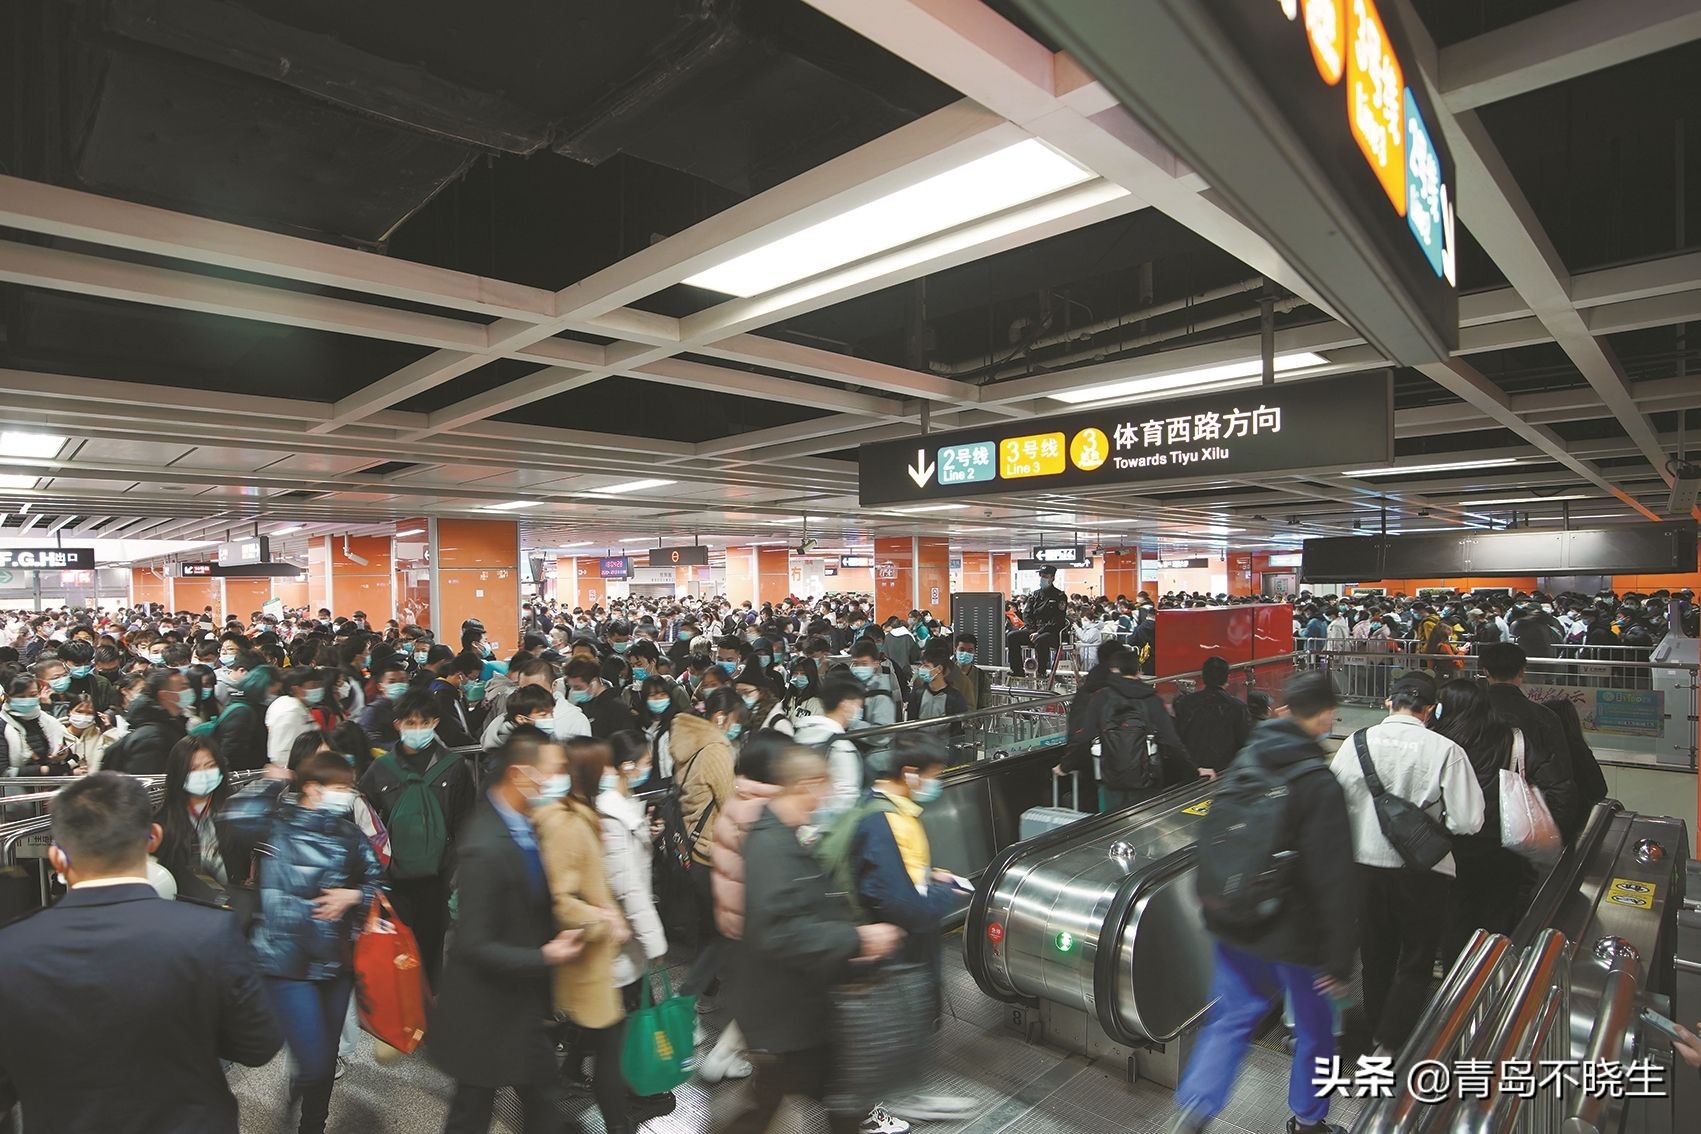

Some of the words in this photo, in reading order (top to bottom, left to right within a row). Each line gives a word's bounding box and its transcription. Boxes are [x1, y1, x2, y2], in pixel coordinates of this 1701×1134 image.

[1113, 405, 1281, 450] 体育西路方向
[1006, 438, 1059, 464] 3号线
[1082, 429, 1098, 451] 3
[943, 446, 990, 471] 2号线
[1006, 463, 1030, 476] Line
[1032, 462, 1041, 474] 3
[1113, 453, 1168, 469] Towards
[1169, 450, 1199, 466] Tiyu
[1201, 447, 1230, 462] Xilu
[943, 470, 965, 481] Line
[967, 468, 975, 479] 2
